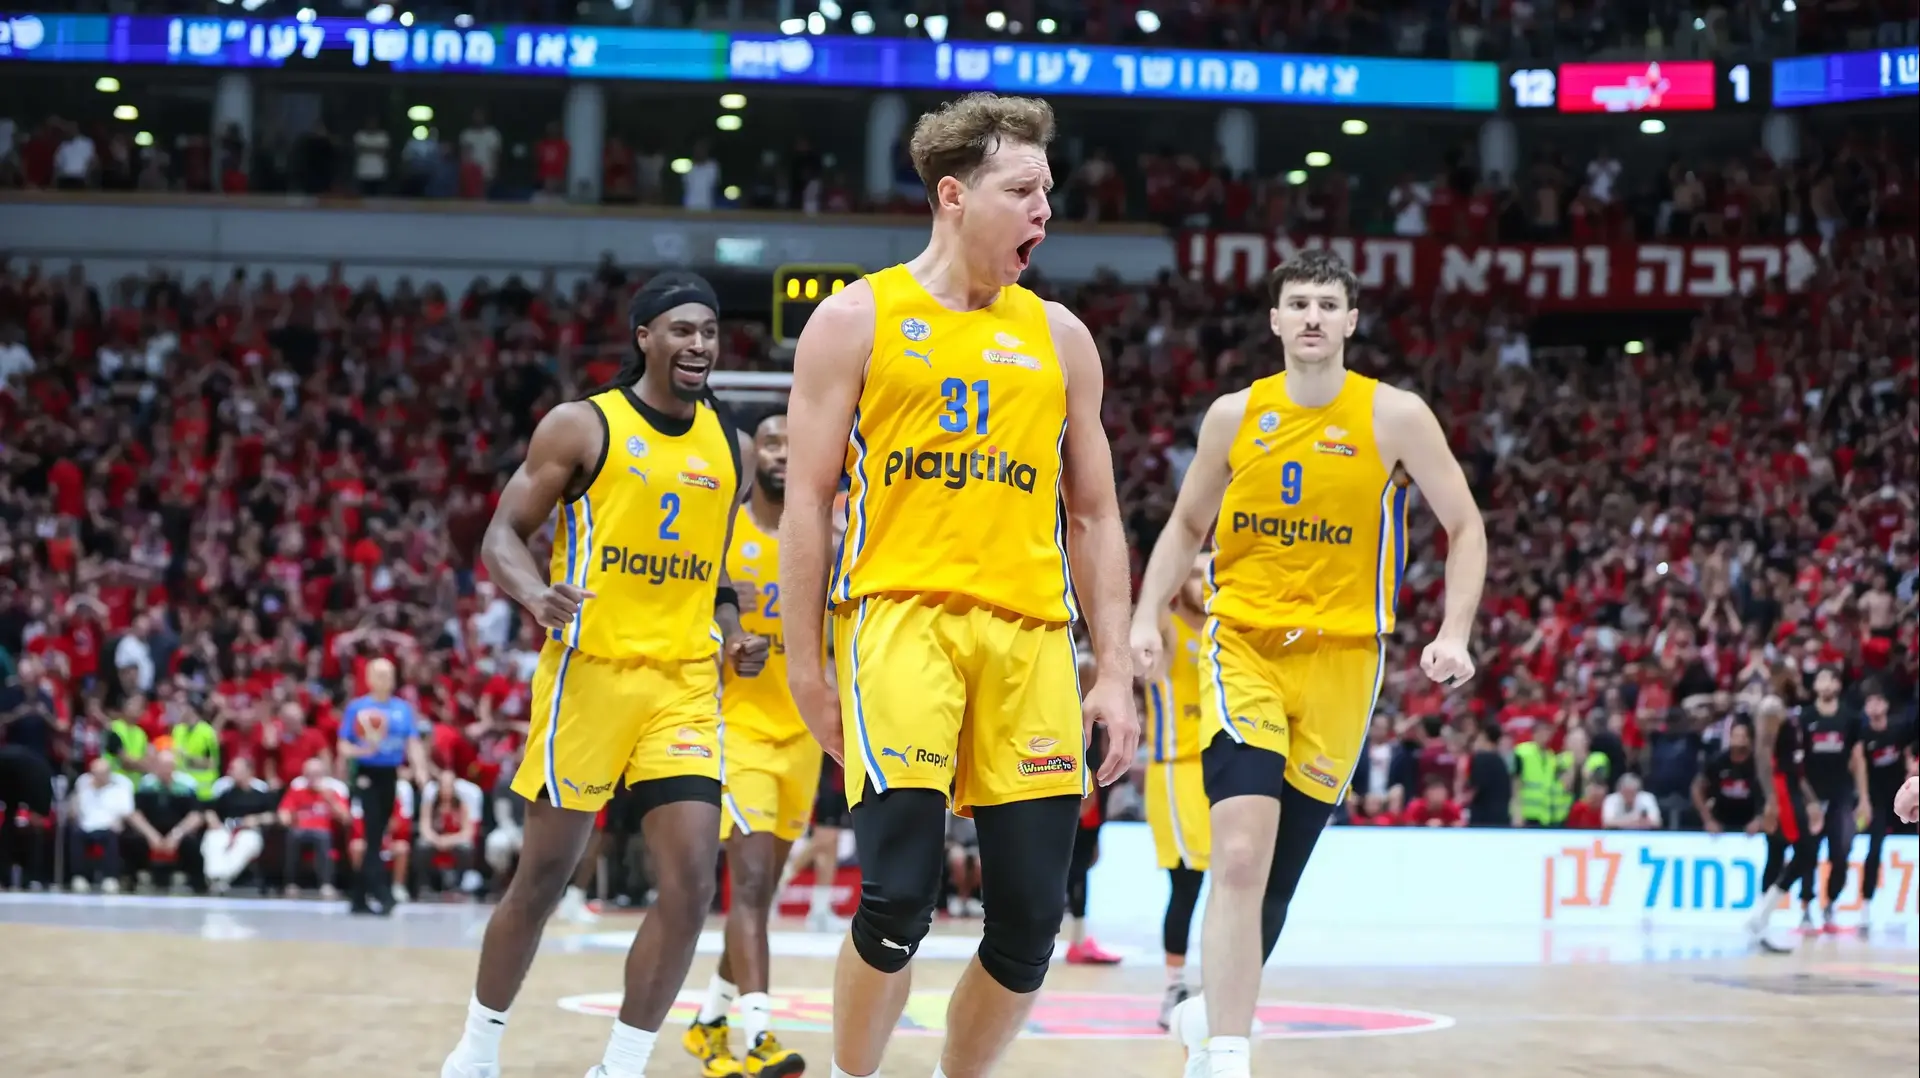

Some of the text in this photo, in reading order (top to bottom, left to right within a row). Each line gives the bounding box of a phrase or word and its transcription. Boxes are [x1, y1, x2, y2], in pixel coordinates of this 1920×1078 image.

[345, 28, 495, 66] מחושך
[516, 32, 598, 67] צאו
[1113, 54, 1259, 93] מחושך
[1281, 62, 1358, 96] צאו
[1509, 69, 1556, 107] 12
[1440, 245, 1609, 299] והיא
[939, 378, 989, 435] 31
[1281, 461, 1303, 505] 9
[659, 492, 680, 541] 2
[1233, 511, 1352, 546] Playtika
[1022, 763, 1062, 773] Winner
[1543, 839, 1622, 919] לבן
[1639, 846, 1756, 910] כחול
